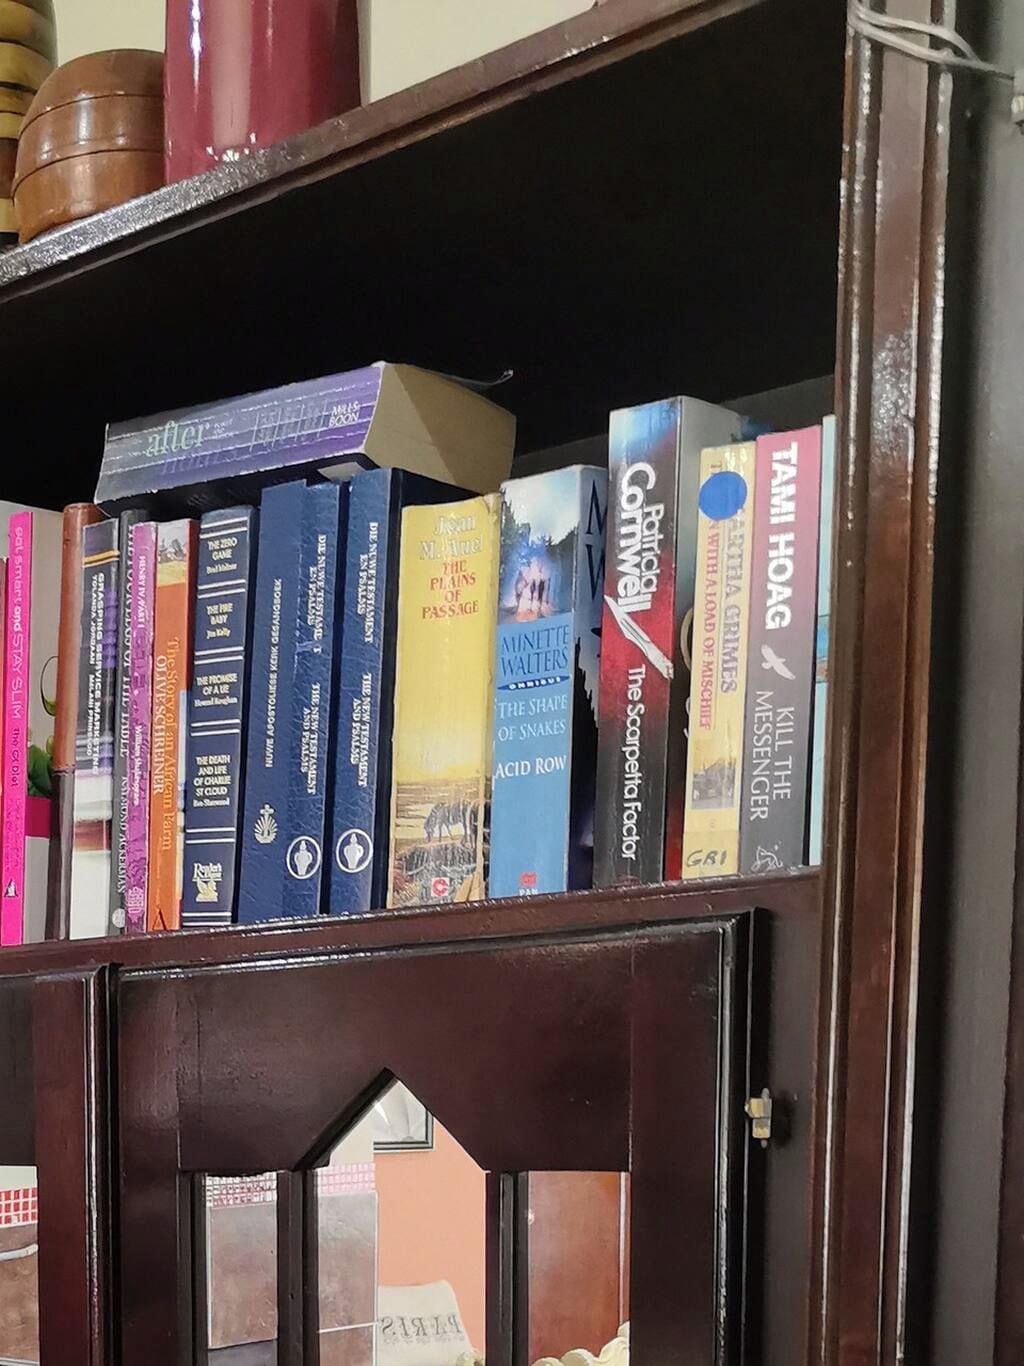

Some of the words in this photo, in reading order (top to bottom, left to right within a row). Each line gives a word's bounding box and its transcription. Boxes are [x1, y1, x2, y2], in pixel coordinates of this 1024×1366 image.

[145, 420, 211, 457] after
[769, 441, 798, 525] TAMI
[14, 527, 24, 554] eat
[368, 521, 379, 542] DIE
[434, 515, 476, 536] Jean
[617, 462, 656, 613] Cornwell
[208, 540, 220, 551] THE
[221, 537, 237, 549] ZERO
[212, 549, 232, 561] GAME
[317, 534, 327, 555] DIE
[367, 543, 378, 577] NUWE
[446, 535, 483, 557] Auel
[640, 502, 665, 594] Patricia
[707, 532, 721, 576] WITH
[138, 555, 147, 586] HENRY
[316, 556, 326, 589] NUWE
[359, 554, 368, 570] EN
[443, 560, 467, 575] THE
[14, 555, 26, 604] smart
[90, 575, 98, 617] YOLANDA
[357, 571, 368, 616] PSALMS
[430, 572, 476, 591] PLAINS
[706, 578, 718, 590] A
[765, 531, 795, 630] HOAG
[95, 573, 105, 639] GRASPING
[206, 606, 219, 615] THE
[271, 578, 283, 644] GESANGBOEK
[364, 578, 377, 644] TESTAMENT
[422, 600, 480, 620] PASSAGE
[445, 590, 462, 603] OF
[704, 591, 718, 634] LOAD
[12, 605, 24, 632] and
[12, 632, 24, 674] STAY
[89, 620, 97, 665] JORDAAN
[167, 637, 180, 670] The
[502, 624, 569, 654] MINETTE
[703, 637, 715, 657] OF
[721, 604, 742, 694] GRIMES
[94, 643, 103, 698] SERVICE
[269, 645, 280, 670] KERK
[501, 646, 568, 677] WALTERS
[155, 655, 168, 700] OLIVE
[166, 672, 179, 707] Story
[197, 676, 209, 686] THE
[209, 673, 238, 683] PROMISE
[202, 687, 212, 695] OF
[212, 686, 219, 694] A
[311, 682, 321, 705] THE
[362, 672, 372, 696] THE
[627, 664, 646, 701] The
[12, 678, 24, 721] SLIM
[266, 673, 279, 736] APOSTOLIESE
[353, 697, 362, 721] AND
[361, 697, 372, 721] NEW
[498, 700, 527, 719] THE
[528, 694, 568, 716] SHAPE
[698, 662, 715, 731] MISCHIEF
[166, 708, 177, 729] of
[302, 707, 311, 730] AND
[309, 707, 320, 731] NEW
[498, 726, 517, 741] OF
[519, 719, 567, 740] SNAKES
[774, 707, 795, 752] KILL
[92, 702, 102, 775] MARKETING
[152, 701, 166, 794] SCHREINER
[166, 732, 175, 752] an
[264, 738, 276, 768] NUWE
[300, 732, 310, 773] PSALMS
[350, 722, 362, 765] PSALMS
[358, 722, 371, 788] TESTAMENT
[621, 702, 645, 800] Scarpetta
[196, 756, 209, 766] THE
[209, 754, 230, 764] DEATH
[198, 767, 214, 776] AND
[214, 765, 228, 774] LIFE
[307, 731, 319, 795] TESTAMENT
[495, 760, 531, 779] ACID
[535, 755, 567, 775] ROW
[750, 691, 774, 822] MESSENGER
[163, 754, 175, 808] African
[193, 777, 204, 787] OF
[204, 776, 232, 785] CHARLIE
[196, 787, 205, 796] ST
[205, 786, 228, 796] CLOUD
[772, 756, 792, 800] THE
[162, 811, 176, 850] Farm
[621, 802, 642, 861] Factor
